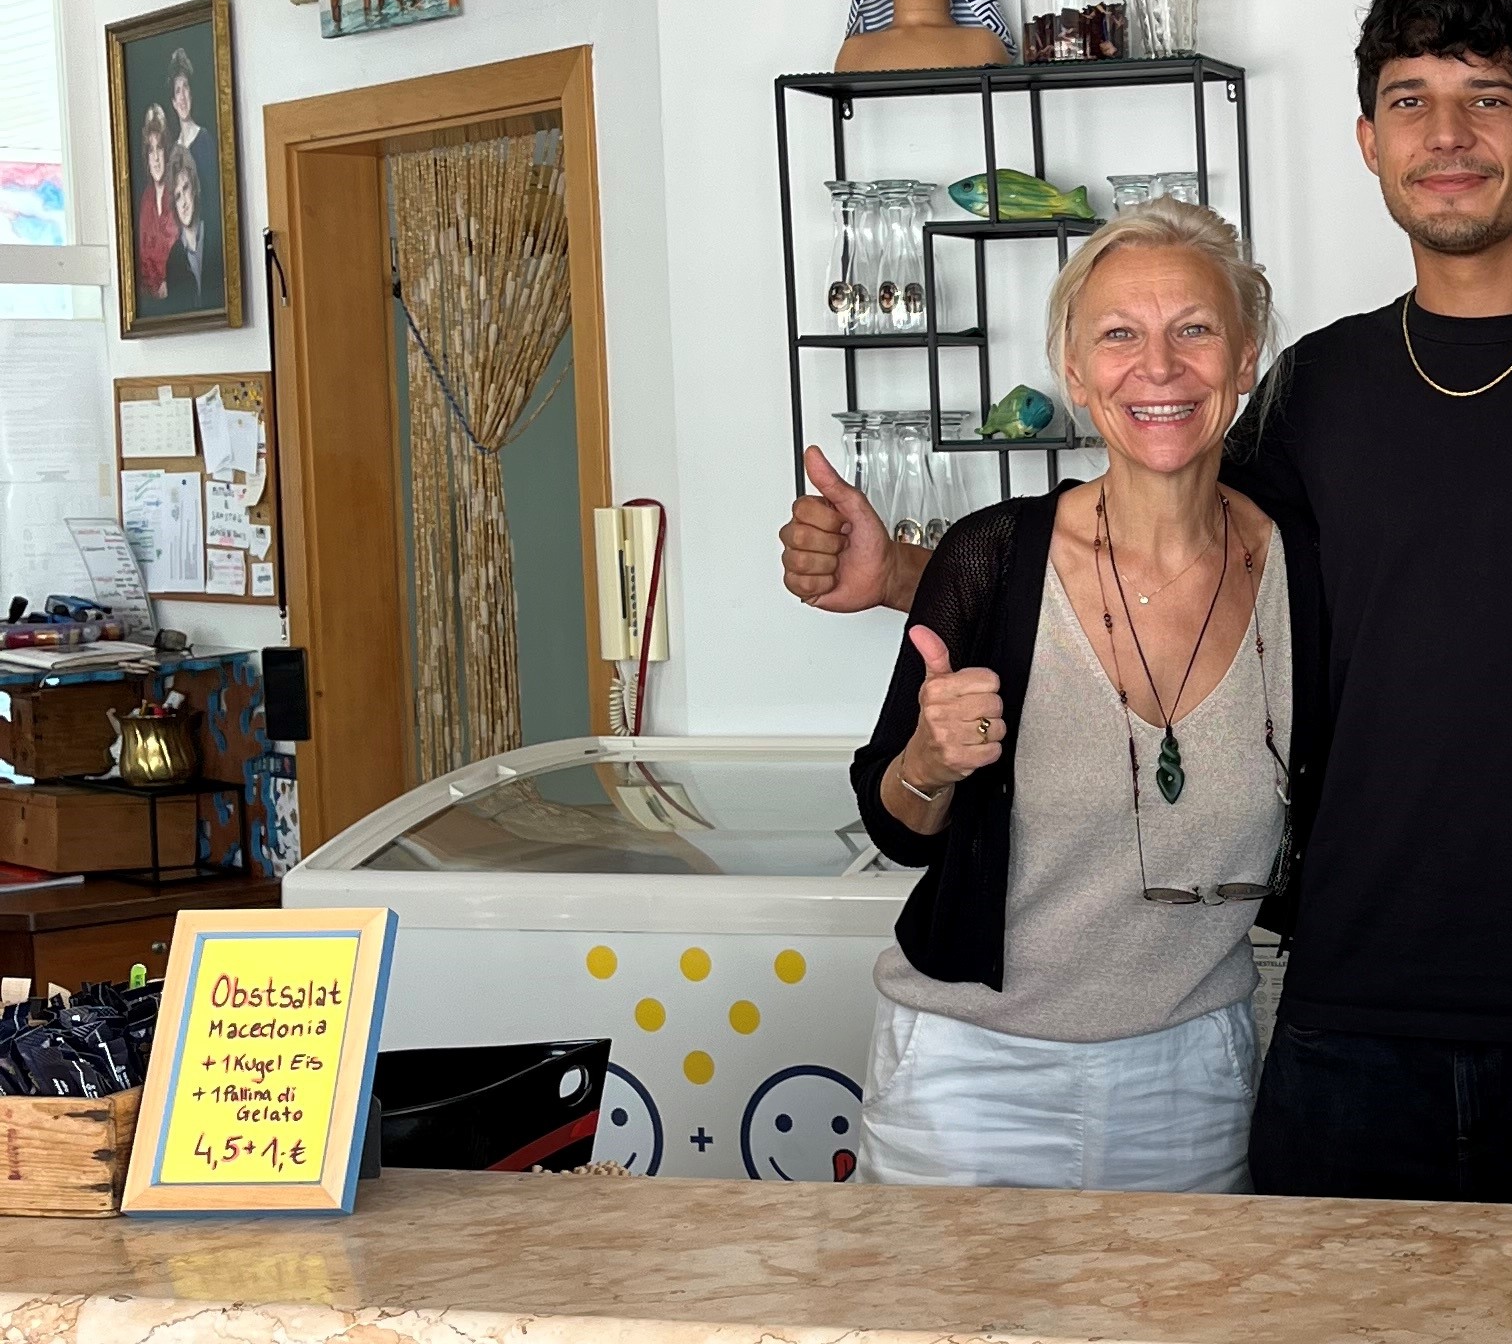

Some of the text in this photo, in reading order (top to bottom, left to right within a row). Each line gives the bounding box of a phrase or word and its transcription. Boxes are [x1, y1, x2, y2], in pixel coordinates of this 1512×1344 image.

[211, 973, 342, 1009] Obstsalat
[208, 1018, 327, 1040] Macedonia
[290, 1053, 323, 1071] Eis
[277, 1085, 296, 1103] di
[236, 1105, 303, 1123] Gelato
